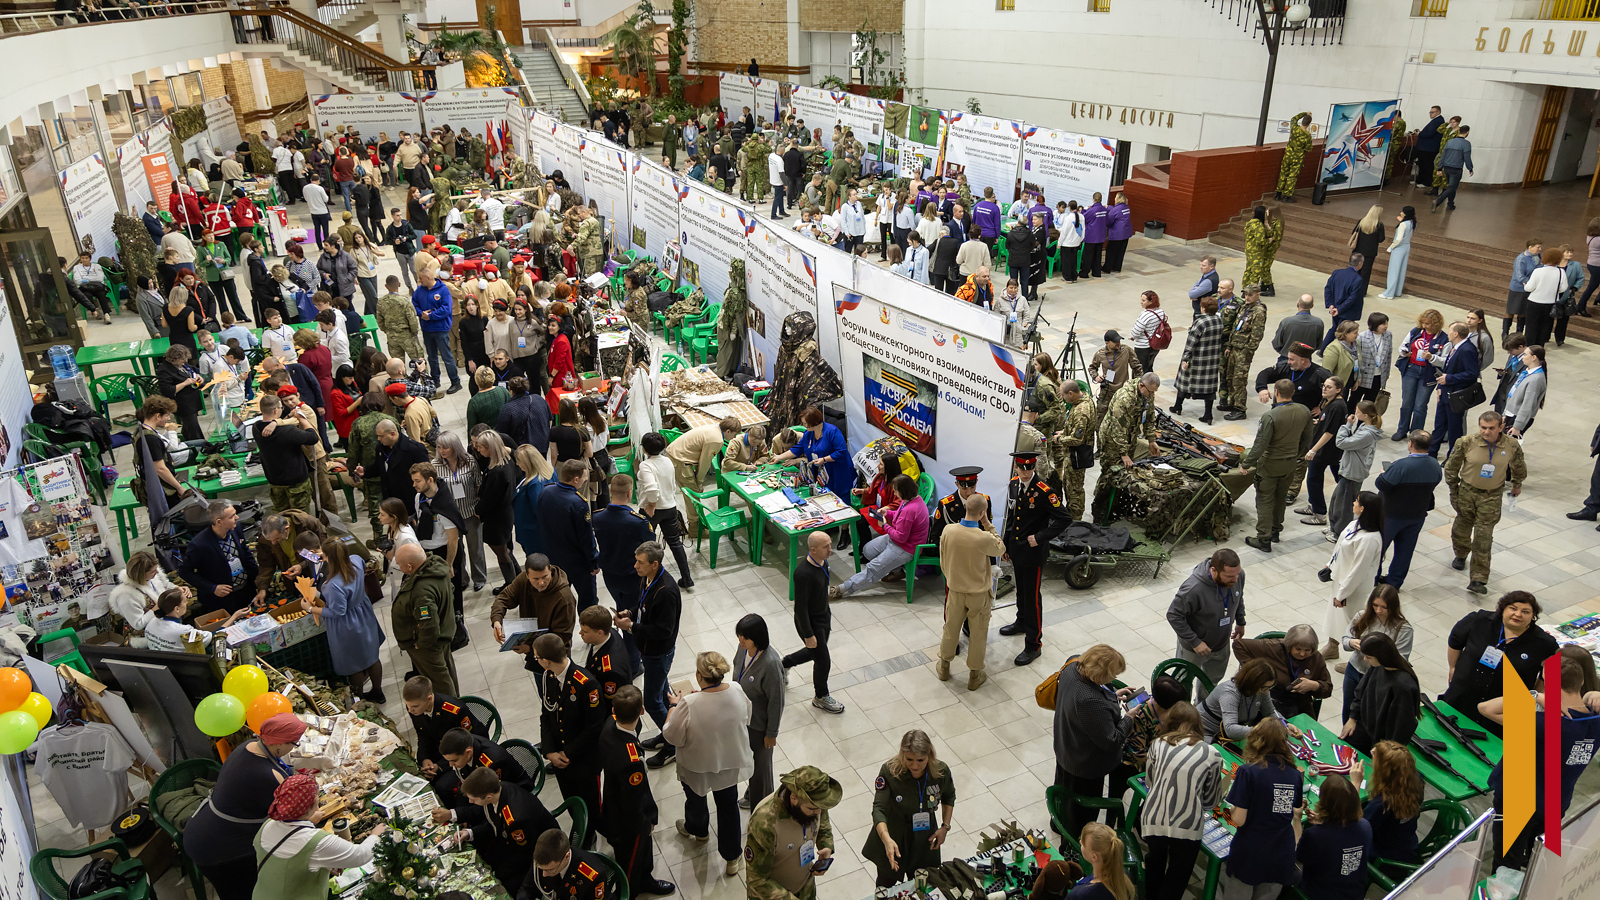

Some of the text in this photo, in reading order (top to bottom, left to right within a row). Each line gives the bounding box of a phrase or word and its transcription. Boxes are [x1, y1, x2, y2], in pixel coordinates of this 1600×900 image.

[1475, 26, 1600, 58] БОЛЬШ
[1071, 101, 1174, 129] ЦЕНТР ДОСУГА
[841, 331, 1016, 416] «Общество в условиях проведения СВО»
[842, 316, 1016, 400] Форум межсекторного взаимодействия
[880, 384, 920, 413] #СВОИХ
[944, 391, 986, 420] бойцам!
[870, 394, 883, 412] НЕ
[884, 401, 933, 437] БРОСАЕМ
